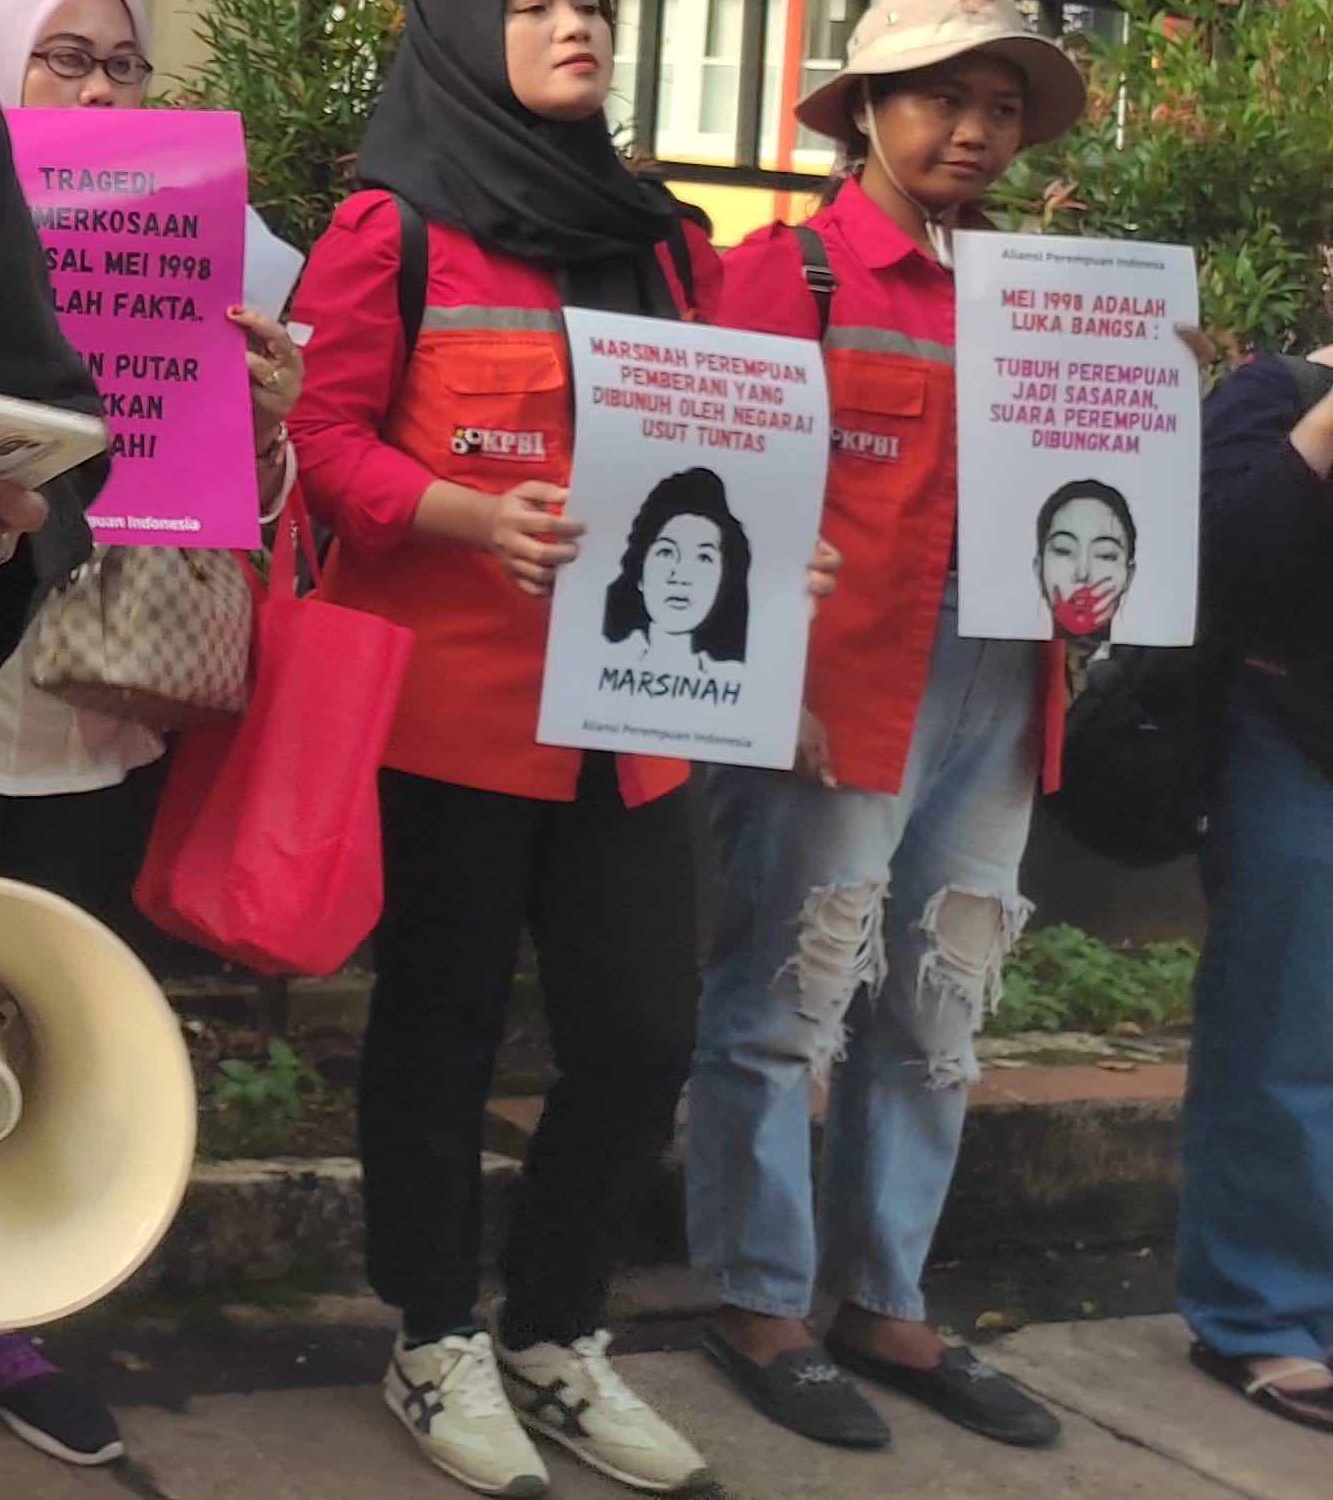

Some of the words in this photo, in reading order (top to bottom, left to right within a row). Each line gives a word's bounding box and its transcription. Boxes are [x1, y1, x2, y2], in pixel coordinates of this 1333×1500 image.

[37, 167, 156, 196] TRAGEDI
[105, 251, 149, 278] MEI
[159, 254, 211, 280] 1998
[1001, 249, 1043, 263] Aliansi
[1046, 252, 1114, 268] Perempuan
[1116, 257, 1165, 271] Indonesia
[113, 293, 204, 321] FAKTA.
[1001, 289, 1035, 308] MEI
[1043, 291, 1084, 311] 1998
[1092, 295, 1165, 318] ADALAH
[1011, 312, 1063, 333] LUKA
[1072, 316, 1147, 339] BANGSA
[116, 355, 199, 382] PUTAR
[590, 337, 687, 369] MARSINAH
[695, 352, 806, 384] PEREMPUAN
[994, 357, 1060, 379] TUBUH
[1068, 363, 1179, 388] PEREMPUAN
[621, 366, 727, 397] PEMBERANI
[735, 381, 784, 405] YANG
[1011, 383, 1057, 403] JADI
[592, 386, 672, 415] DIBUNUH
[680, 402, 725, 423] OLEH
[989, 404, 1055, 426] SUARA
[1065, 409, 1177, 434] PEREMPUAN
[482, 430, 544, 455] KPBI
[642, 419, 686, 441] USUT
[698, 428, 766, 454] TUNTAS
[842, 431, 899, 457] KPBI
[1032, 428, 1140, 454] DIBUNGKAM
[128, 515, 202, 531] Indonesia
[599, 666, 742, 707] MARSINAH
[582, 719, 619, 734] Aliansi
[623, 724, 690, 745] Perempuan
[694, 731, 753, 748] Indonesia
